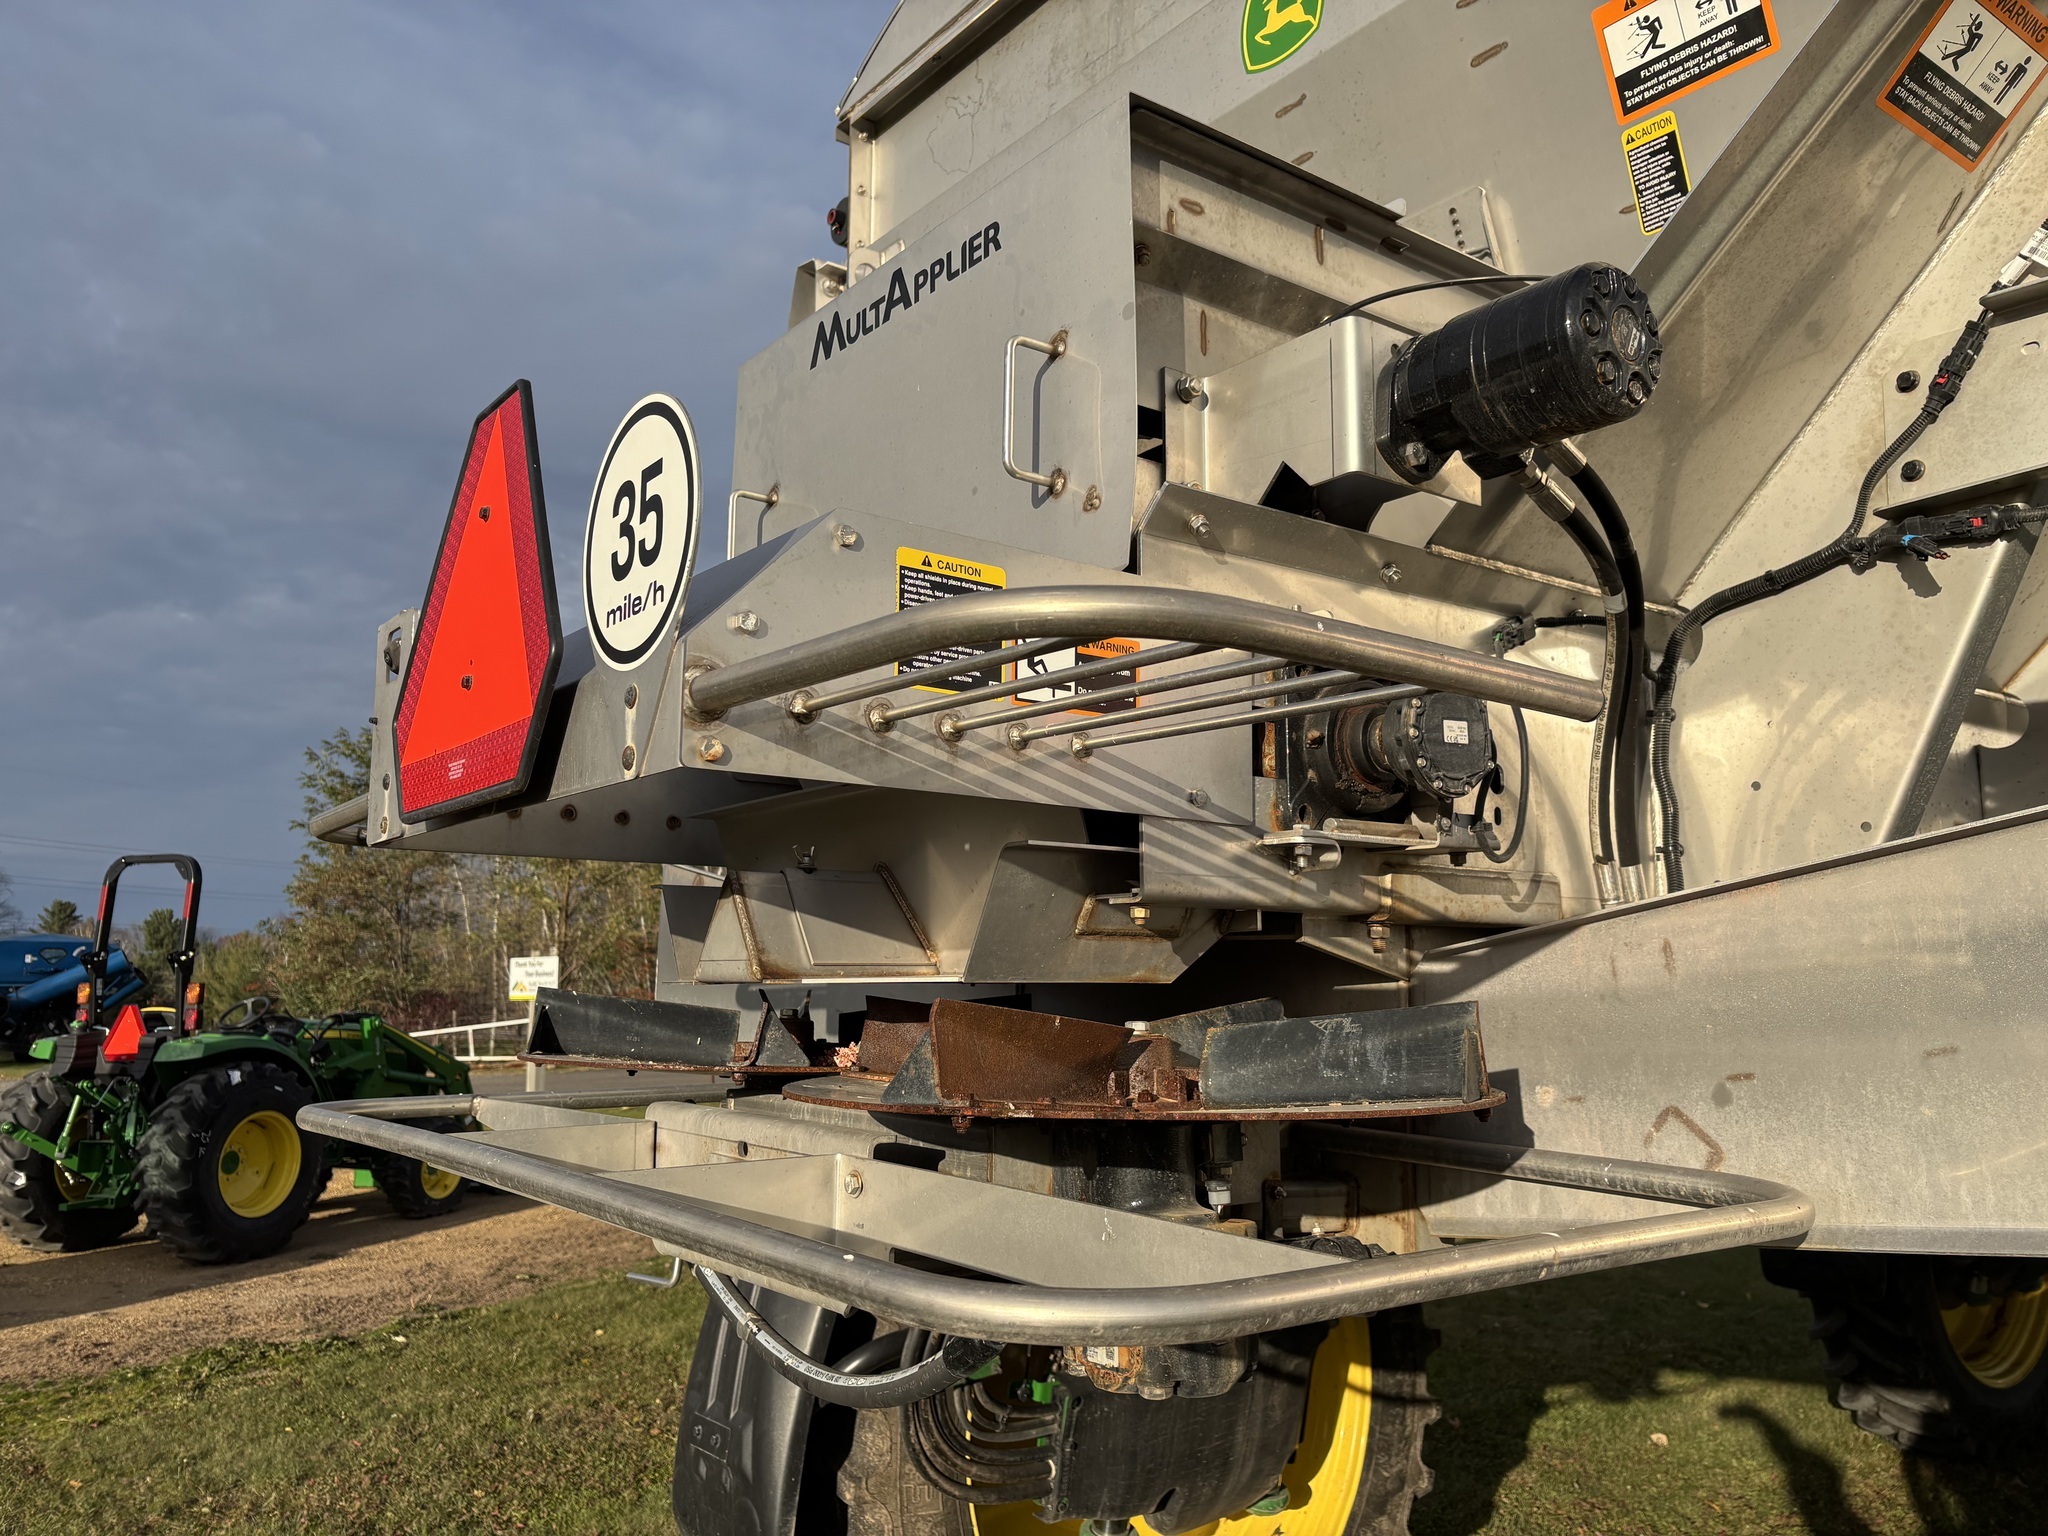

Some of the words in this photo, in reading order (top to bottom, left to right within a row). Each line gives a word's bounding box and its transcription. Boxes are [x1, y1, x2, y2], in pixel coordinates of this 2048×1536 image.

[1697, 5, 1716, 19] KEEP
[1699, 13, 1718, 27] AWAY
[1640, 59, 1669, 78] FLYING
[1669, 43, 1700, 65] DEBRIS
[1700, 24, 1738, 49] HAZARD!
[1623, 90, 1633, 98] To
[1633, 77, 1658, 96] prevent
[1658, 65, 1683, 82] serious
[1683, 54, 1703, 69] injury
[1704, 50, 1712, 59] or
[1713, 40, 1735, 54] death:
[1626, 93, 1643, 107] STAY
[1643, 82, 1666, 99] BACK!
[1666, 66, 1700, 87] OBJECTS
[1700, 57, 1717, 71] CAN
[1716, 52, 1728, 63] BE
[1728, 35, 1765, 57] THROWN!
[1986, 71, 2000, 84] KEEP
[1902, 74, 1910, 85] To
[1907, 81, 1928, 98] prevent
[1925, 93, 1943, 110] serious
[1923, 71, 1946, 91] FLYING
[1942, 85, 1965, 106] DEBRIS
[1961, 99, 1987, 122] HAZARD!
[1979, 81, 1994, 94] AWAY
[1635, 115, 1673, 140] CAUTION
[1894, 86, 1910, 100] STAY
[1907, 94, 1925, 111] BACK!
[1921, 106, 1945, 126] OBJECTS
[1942, 121, 1955, 134] CAN
[1951, 128, 1962, 138] BE
[1959, 132, 1981, 152] THROWN!
[610, 456, 664, 582] 35
[937, 560, 982, 578] CAUTION
[904, 570, 918, 578] Keep
[924, 574, 942, 582] shields
[961, 581, 976, 590] during
[904, 578, 931, 587] operations.
[904, 584, 917, 593] Keep
[917, 587, 934, 596] hands,
[605, 579, 665, 629] mile/h
[1091, 641, 1134, 654] WARNING
[1596, 722, 1604, 744] (3000
[1593, 744, 1602, 760] PSI)
